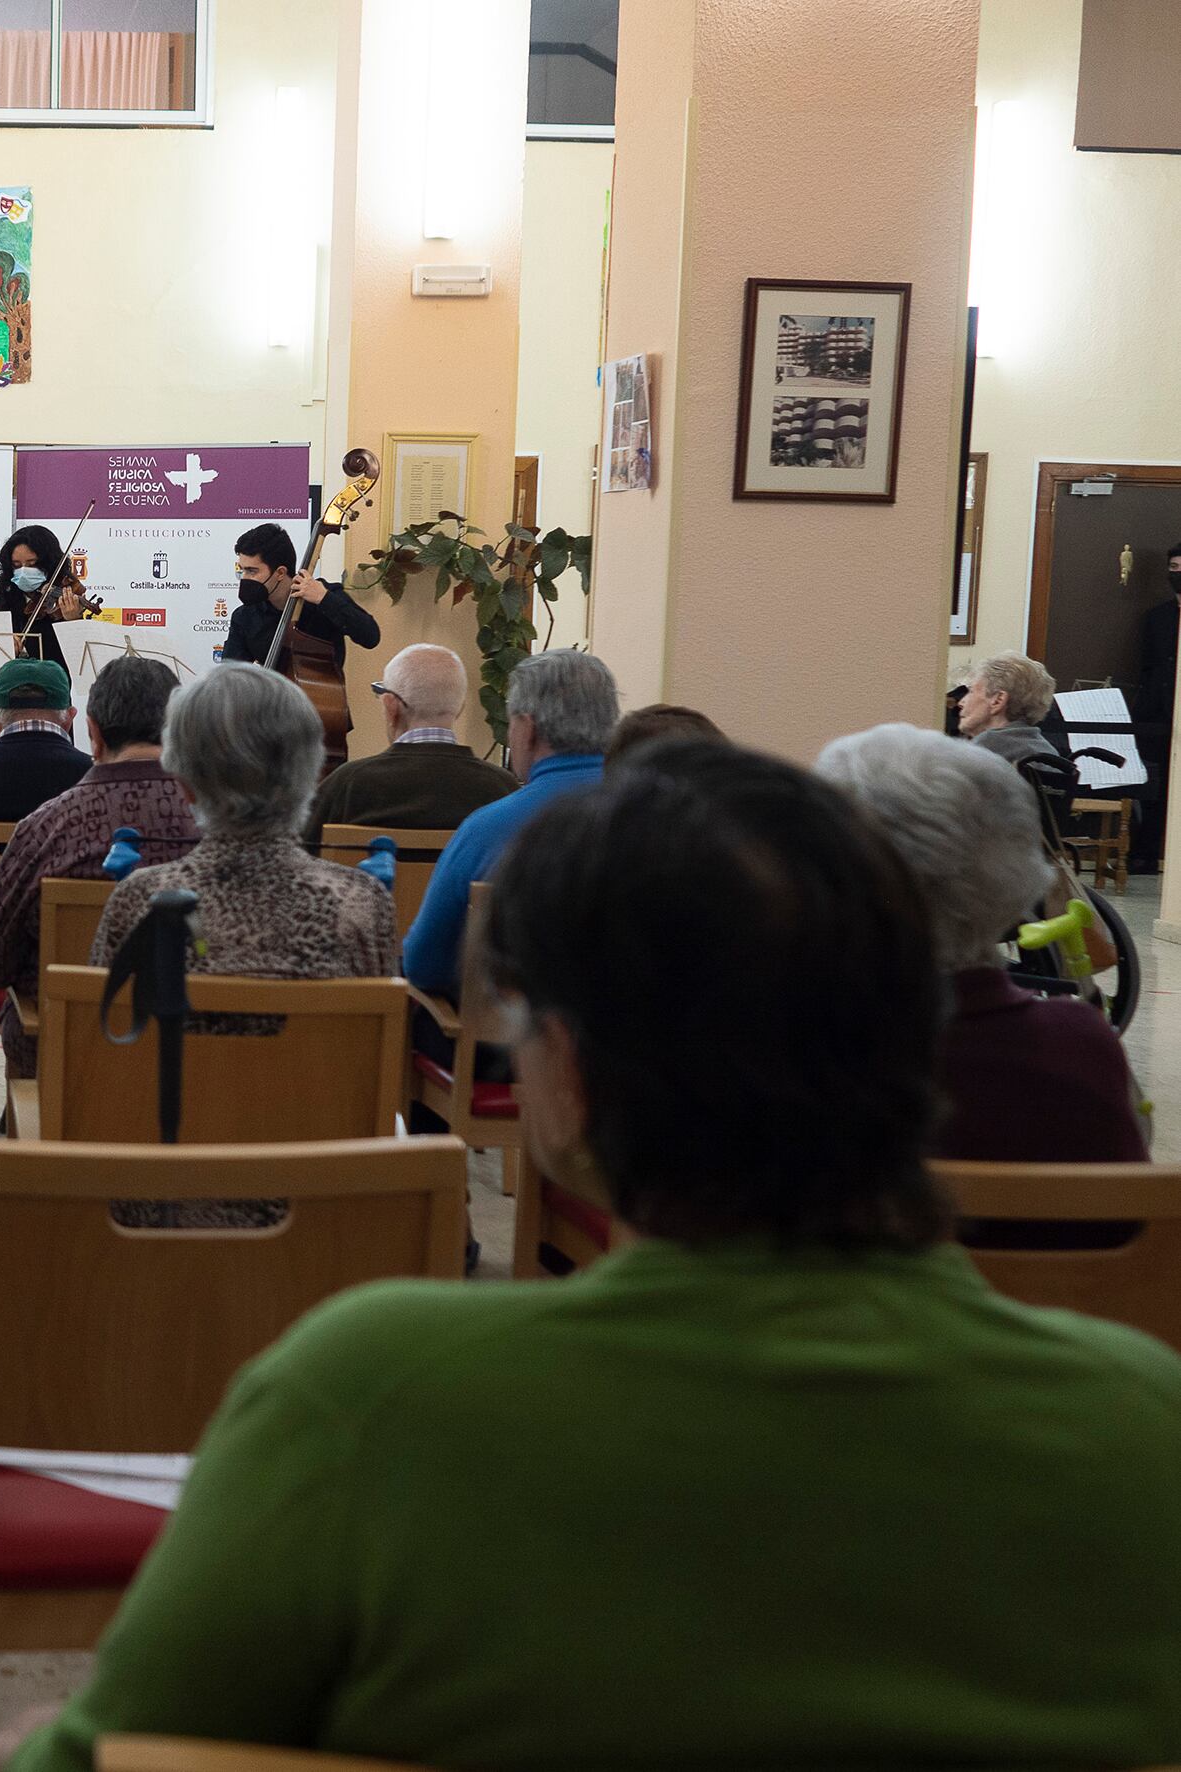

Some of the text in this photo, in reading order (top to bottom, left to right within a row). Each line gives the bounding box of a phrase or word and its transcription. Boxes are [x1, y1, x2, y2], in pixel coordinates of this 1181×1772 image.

[108, 456, 157, 467] SEMANA
[108, 482, 166, 493] RELIGIOSA
[108, 495, 170, 506] DE CUENCA
[108, 527, 211, 538] Instituciones
[166, 582, 190, 590] Mancha
[126, 613, 162, 622] inaem
